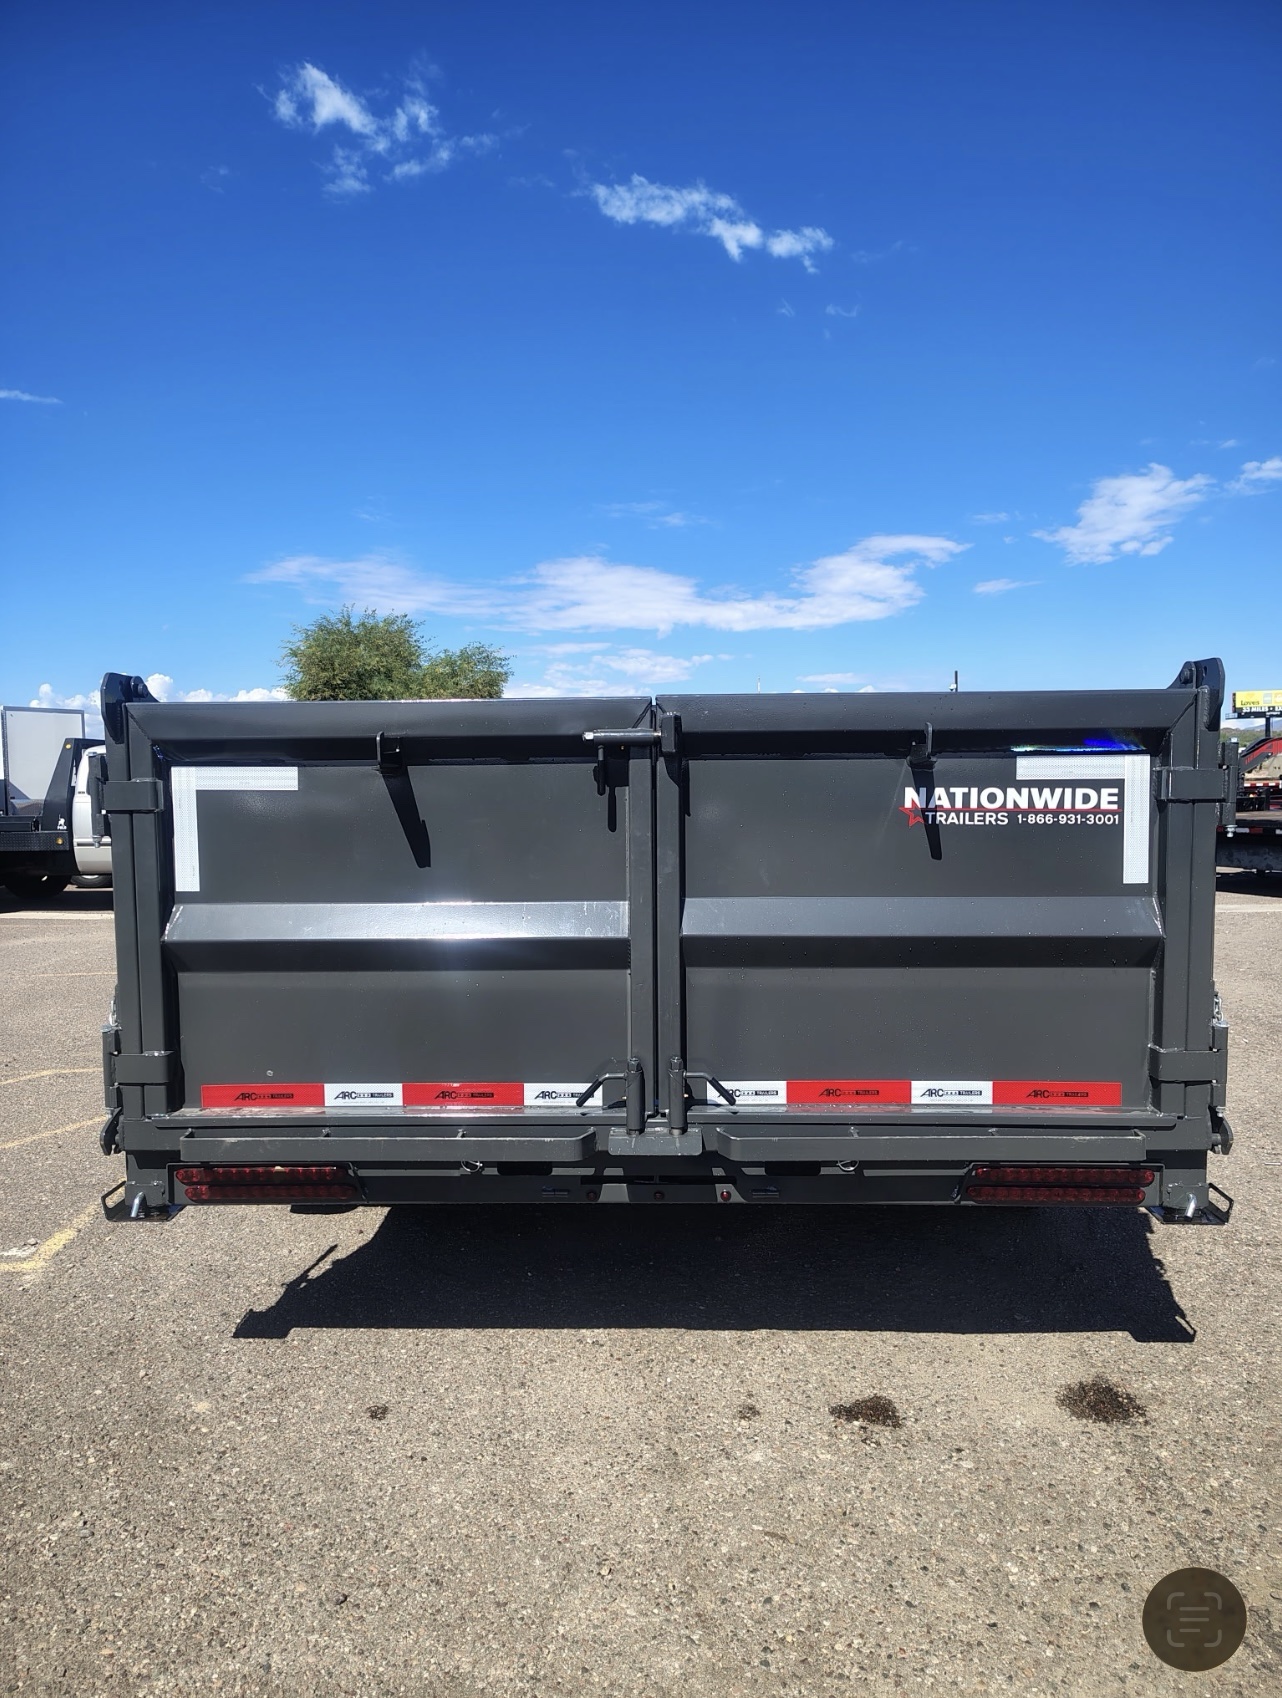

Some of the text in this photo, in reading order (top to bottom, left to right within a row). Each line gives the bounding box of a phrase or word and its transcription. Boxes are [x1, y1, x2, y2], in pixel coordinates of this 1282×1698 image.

[904, 787, 1119, 809] NATIONWIDE
[925, 812, 1119, 825] TRAILERS 1-866-931-3001
[234, 1092, 257, 1101] ARC
[334, 1091, 357, 1100] ARC
[434, 1091, 457, 1099] ARC
[534, 1091, 557, 1099] ARC
[818, 1088, 842, 1097] ARC
[920, 1088, 944, 1098] ARC
[1026, 1089, 1050, 1098] ARC
